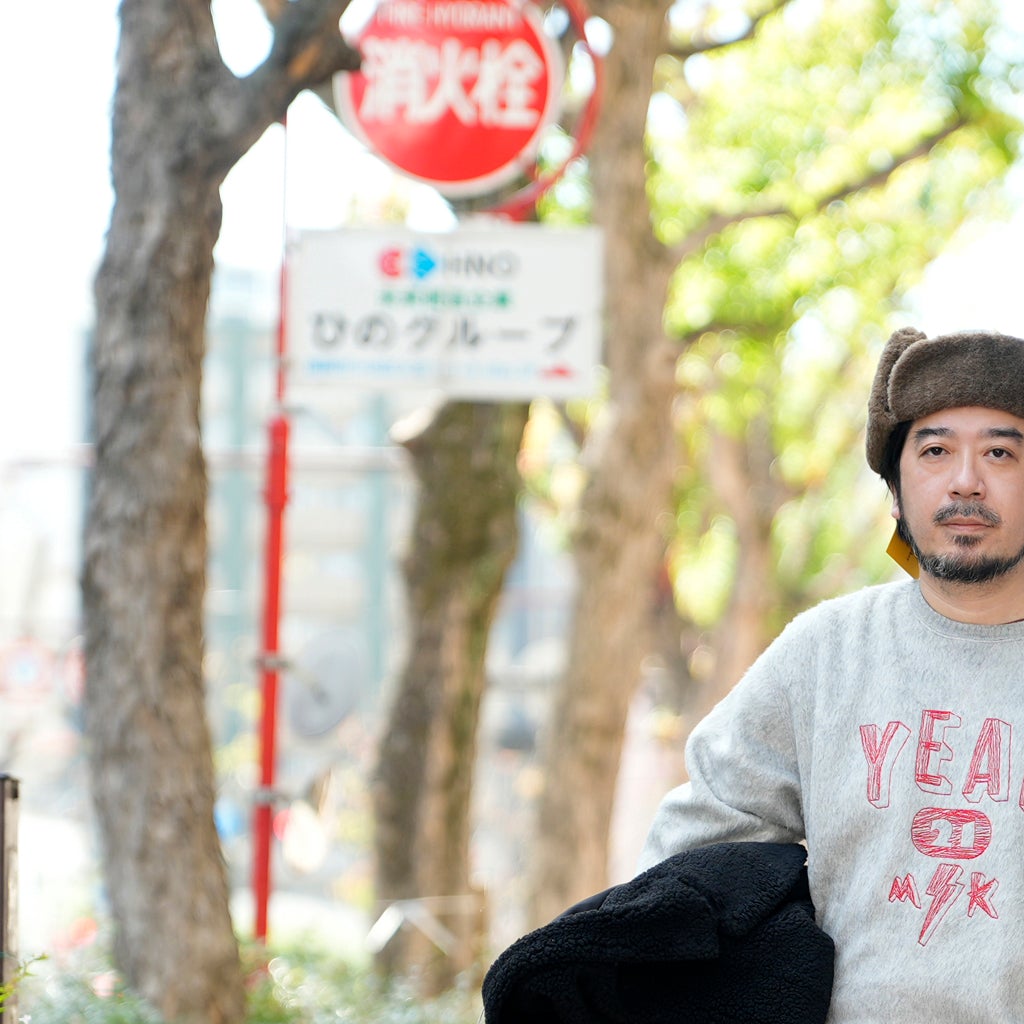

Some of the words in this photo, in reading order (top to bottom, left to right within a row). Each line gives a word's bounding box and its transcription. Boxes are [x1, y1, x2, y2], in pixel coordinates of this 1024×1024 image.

[360, 37, 541, 127] 消火栓
[311, 312, 579, 354] ひのグループ
